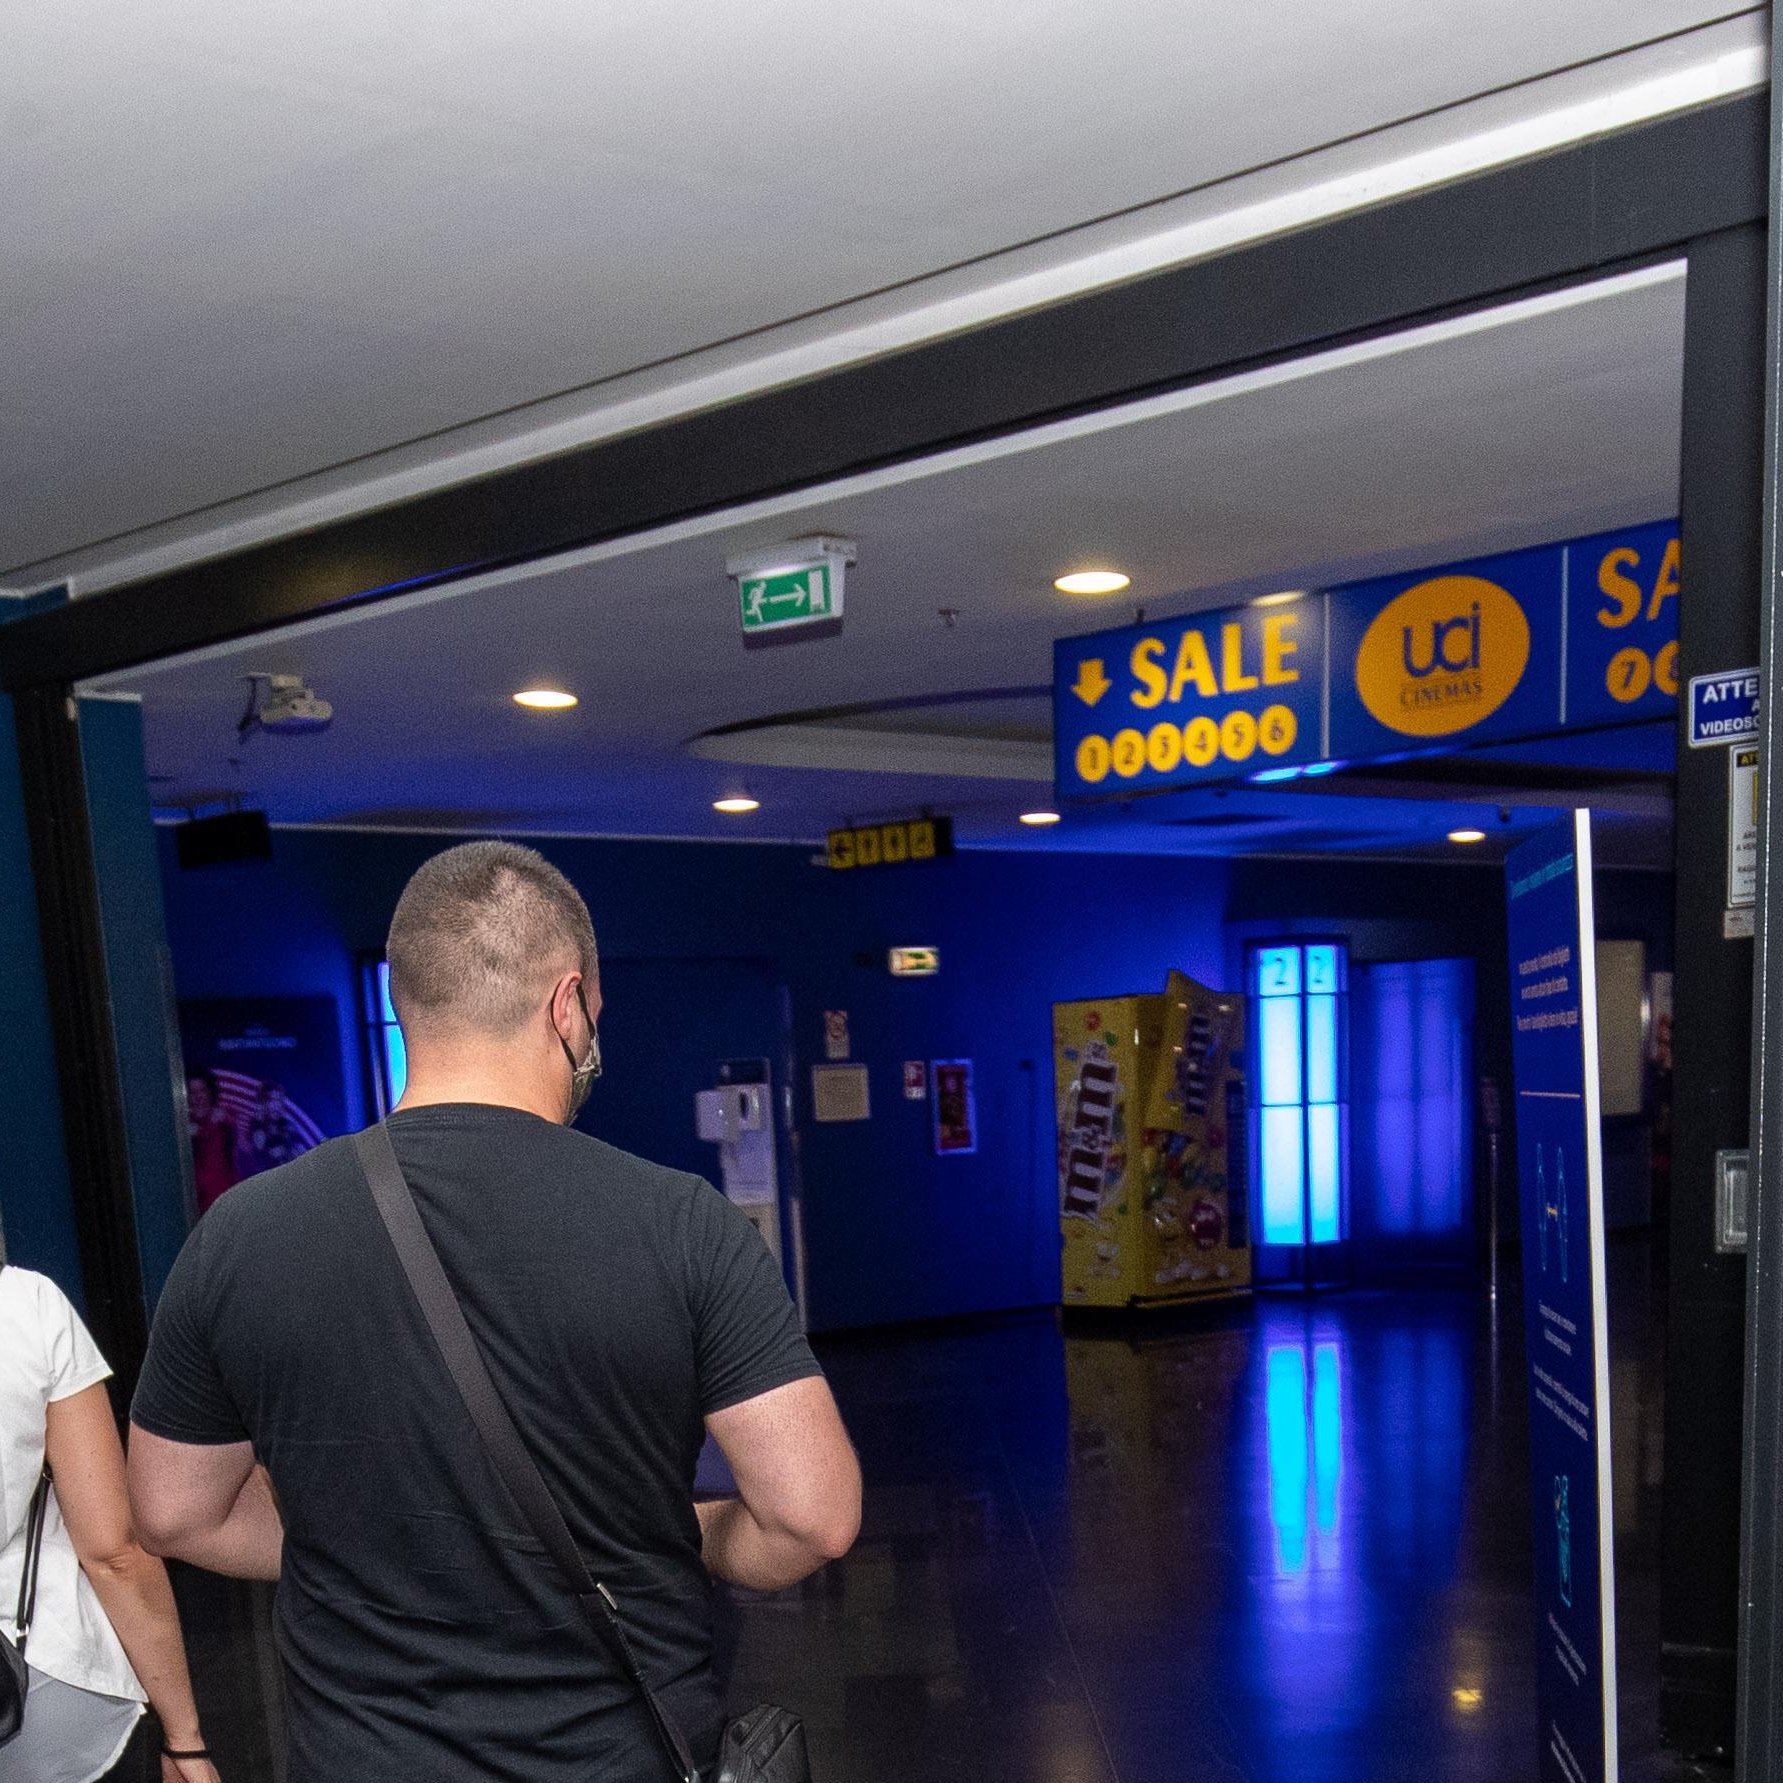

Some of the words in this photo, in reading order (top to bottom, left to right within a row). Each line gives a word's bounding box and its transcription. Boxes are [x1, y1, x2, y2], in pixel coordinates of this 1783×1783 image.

[1129, 612, 1301, 709] SALE
[1402, 601, 1481, 679] uci
[1703, 678, 1758, 704] ATTE
